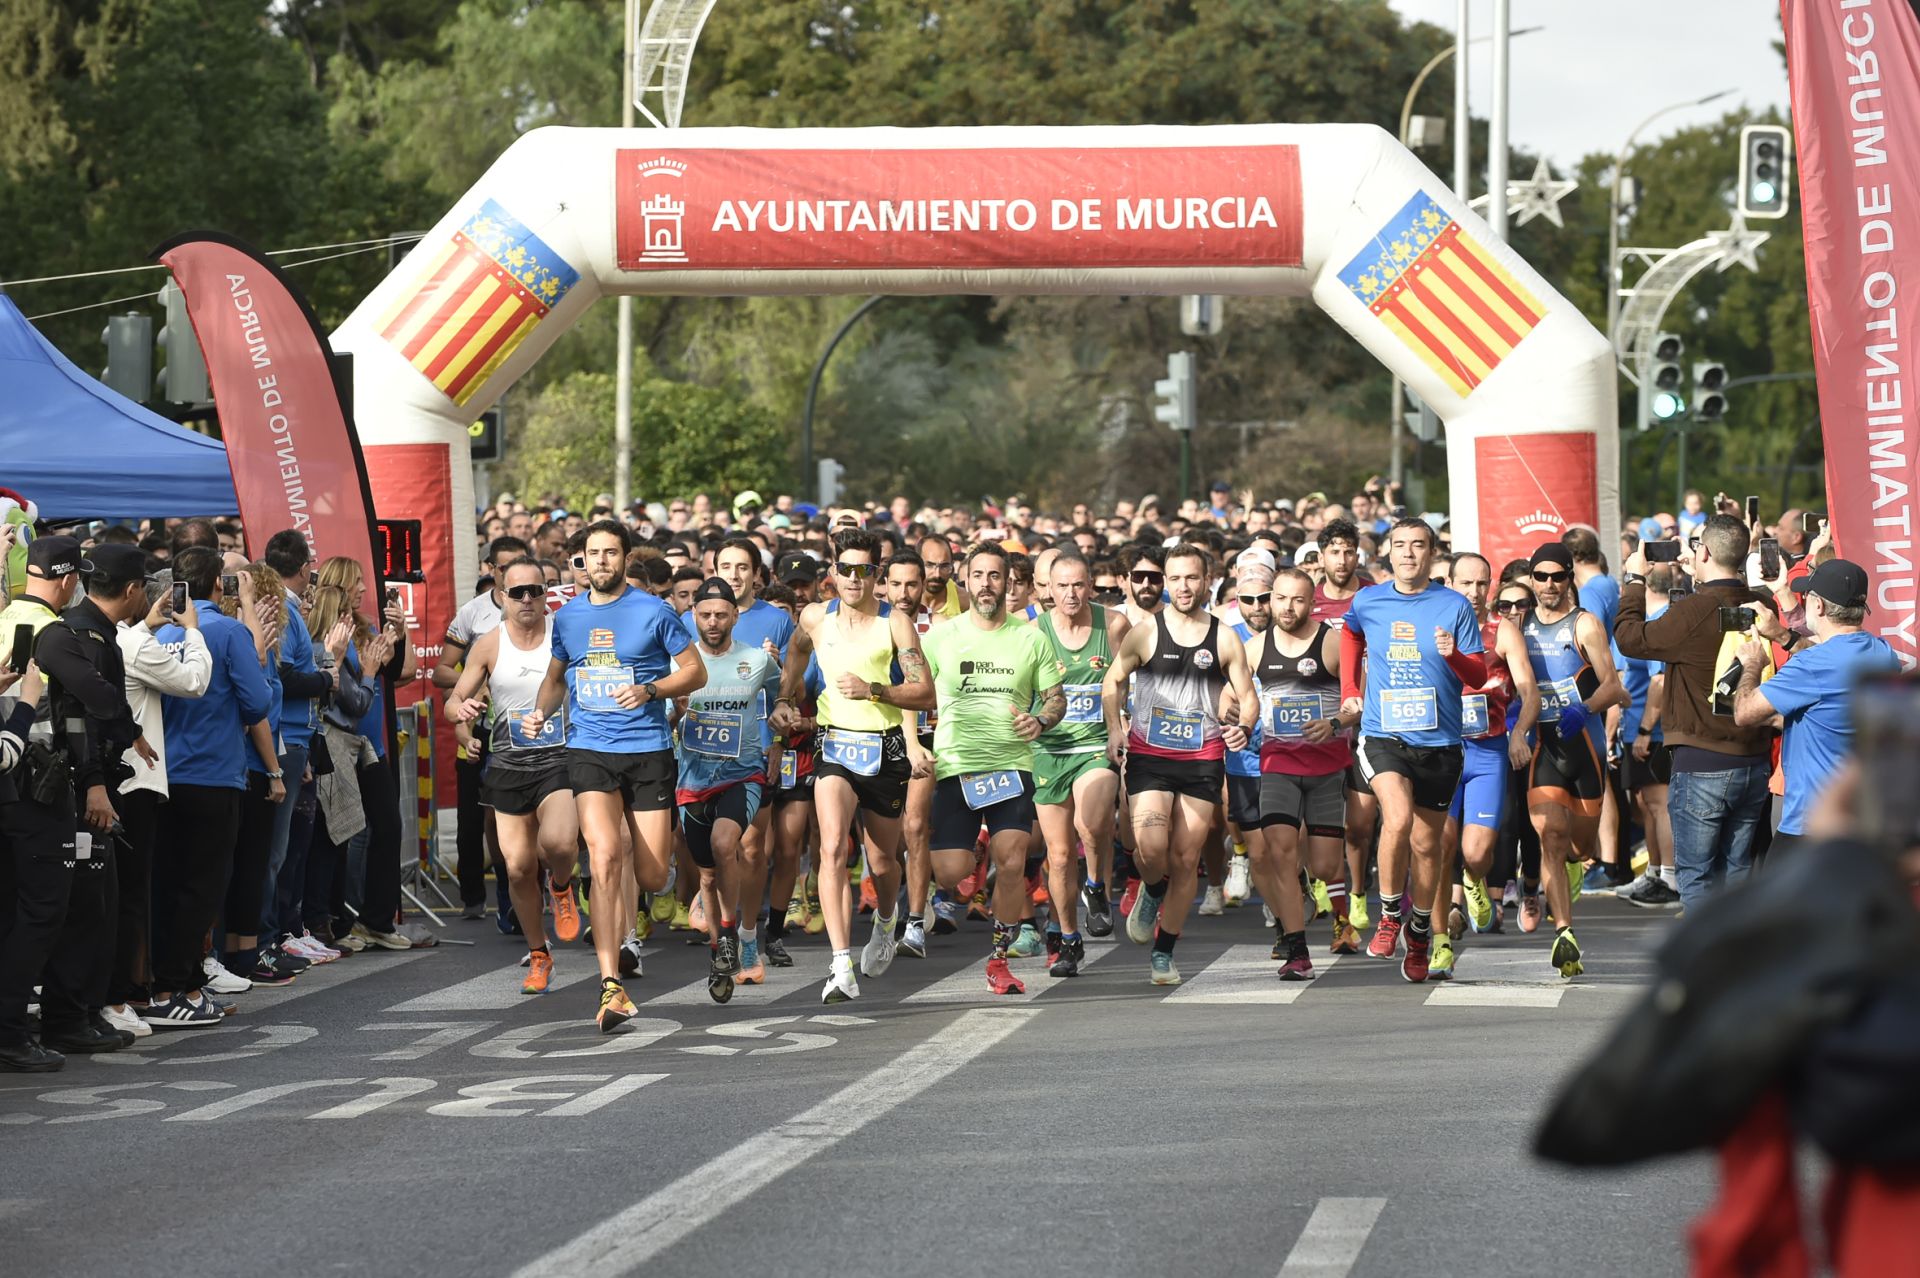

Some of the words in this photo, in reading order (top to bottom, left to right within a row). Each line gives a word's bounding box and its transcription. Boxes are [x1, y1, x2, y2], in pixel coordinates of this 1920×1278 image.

[711, 199, 1037, 233] AYUNTAMIENTO
[1051, 198, 1102, 231] DE
[1116, 196, 1277, 230] MURCIA
[976, 661, 994, 669] pan
[977, 667, 1015, 675] moreno
[582, 682, 628, 698] 410
[704, 701, 749, 711] SIPCAM
[1391, 702, 1426, 719] 565
[1280, 708, 1312, 723] 025
[694, 725, 730, 743] 176
[1159, 721, 1194, 739] 248
[833, 743, 869, 762] 701
[974, 774, 1011, 795] 514
